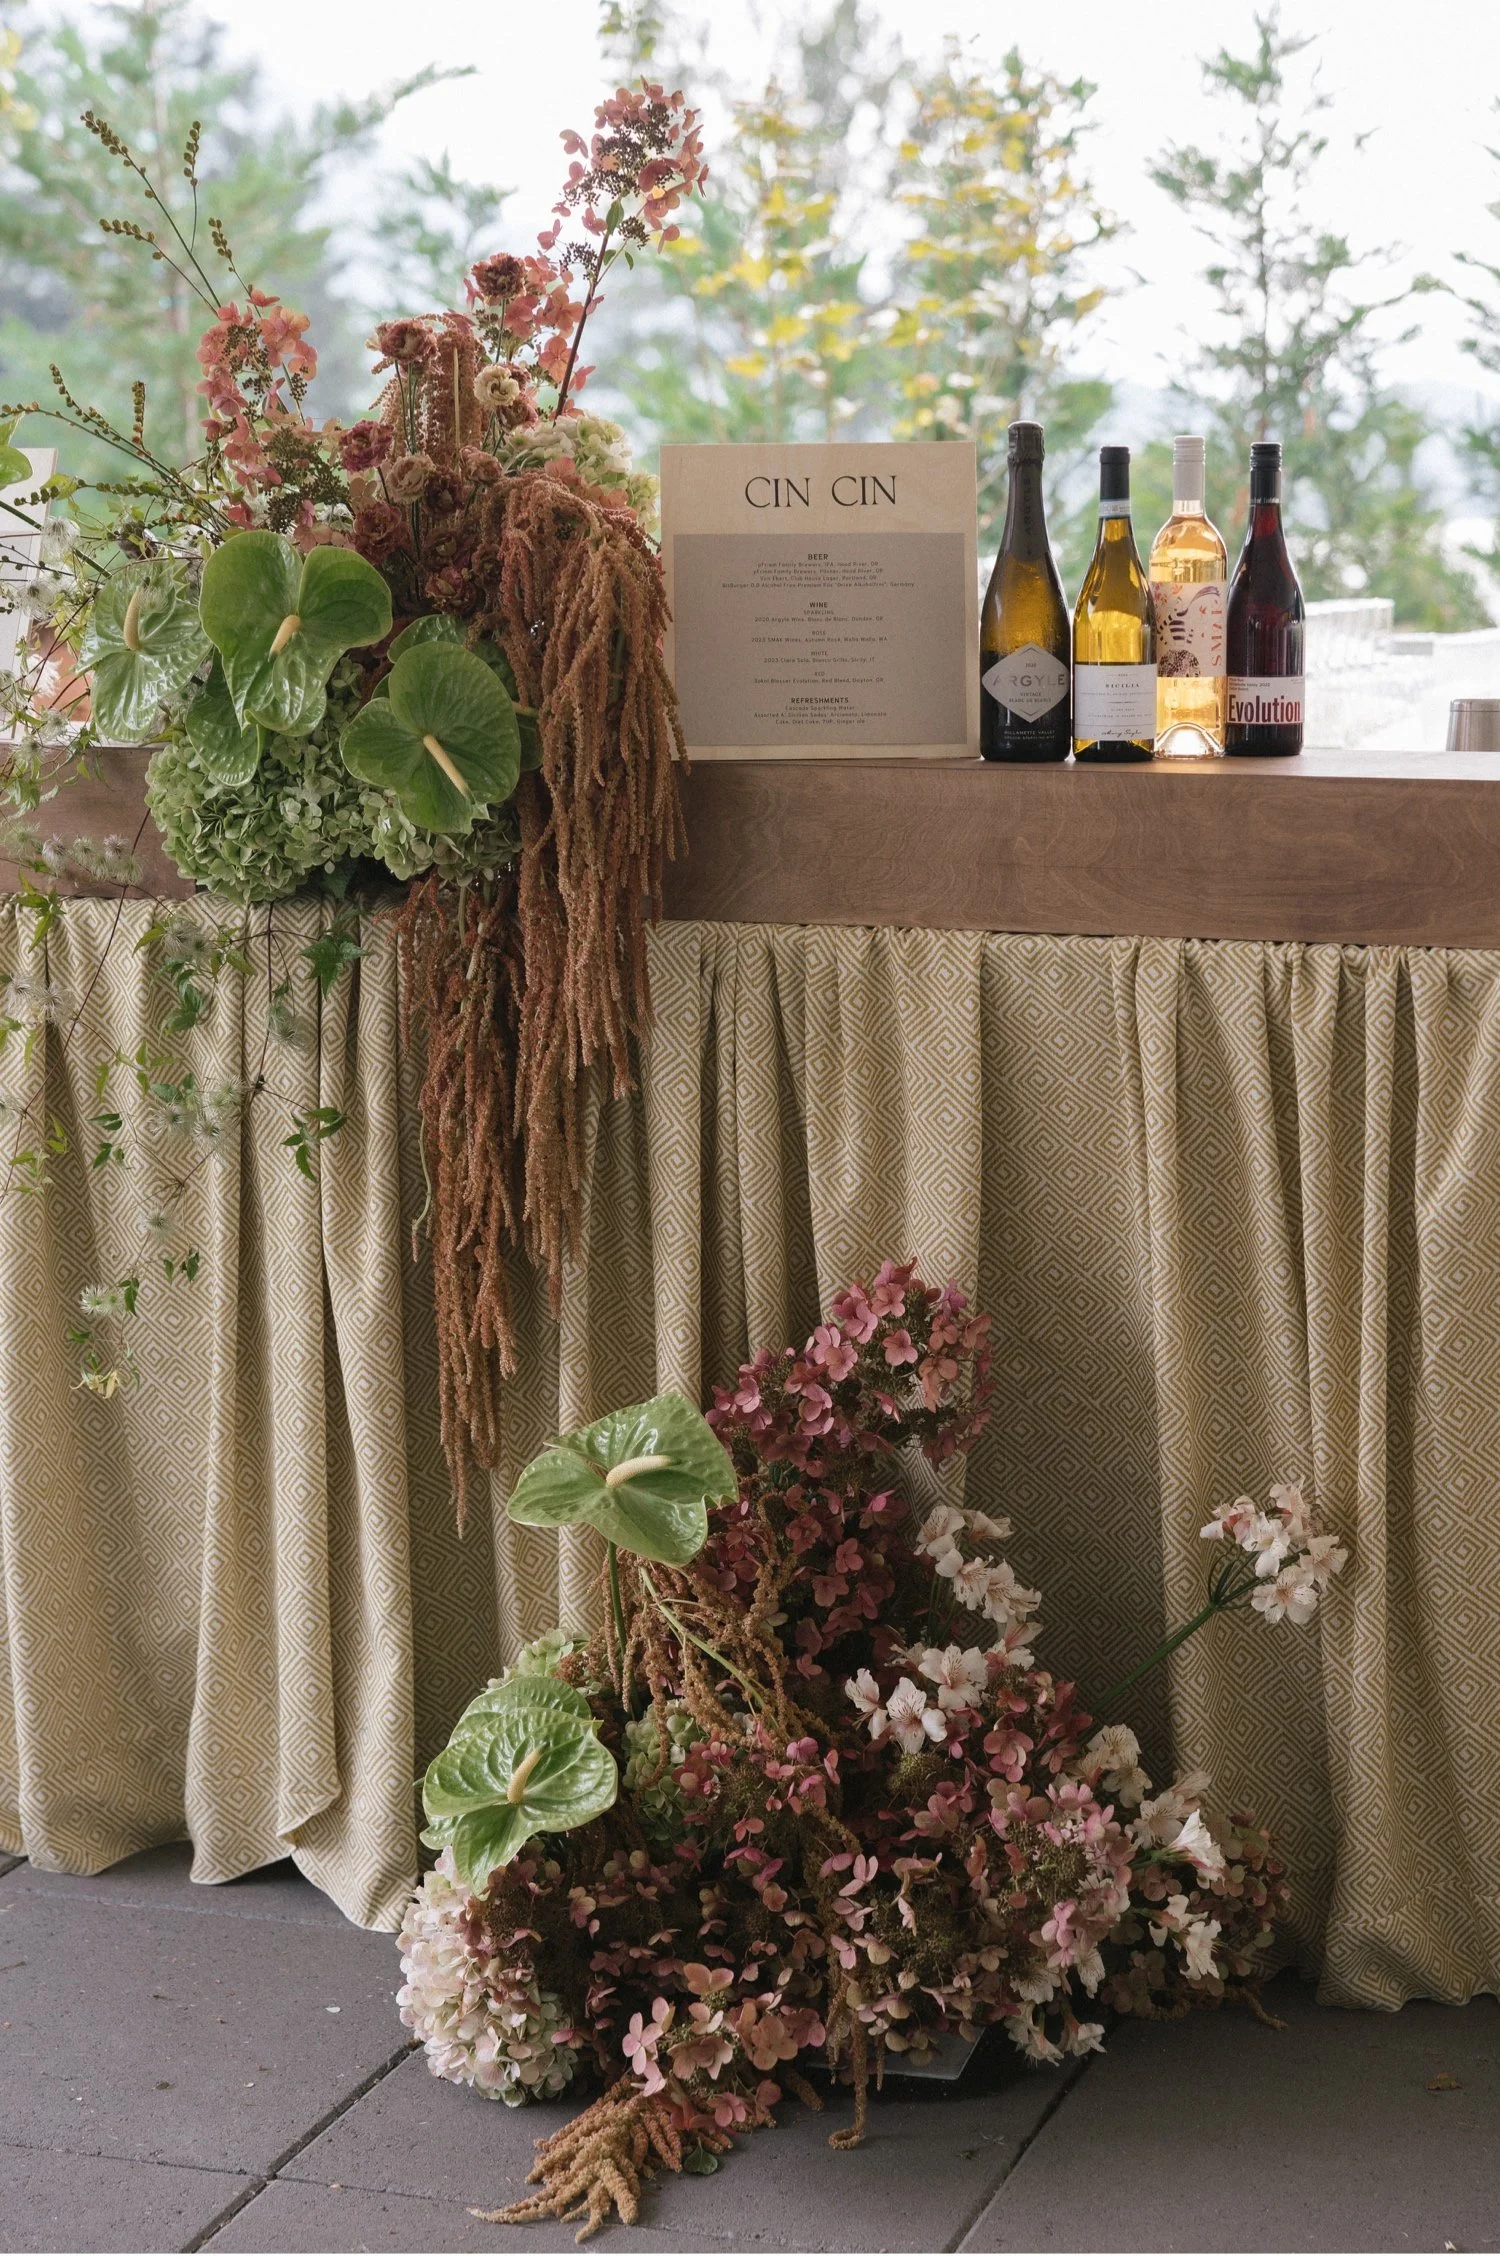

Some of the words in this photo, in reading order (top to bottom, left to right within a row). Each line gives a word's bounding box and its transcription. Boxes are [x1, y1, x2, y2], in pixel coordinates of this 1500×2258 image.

[745, 476, 810, 508] CIN
[832, 476, 896, 506] CIN
[993, 674, 1064, 686] ARGYLE
[1229, 694, 1300, 722] Evolution
